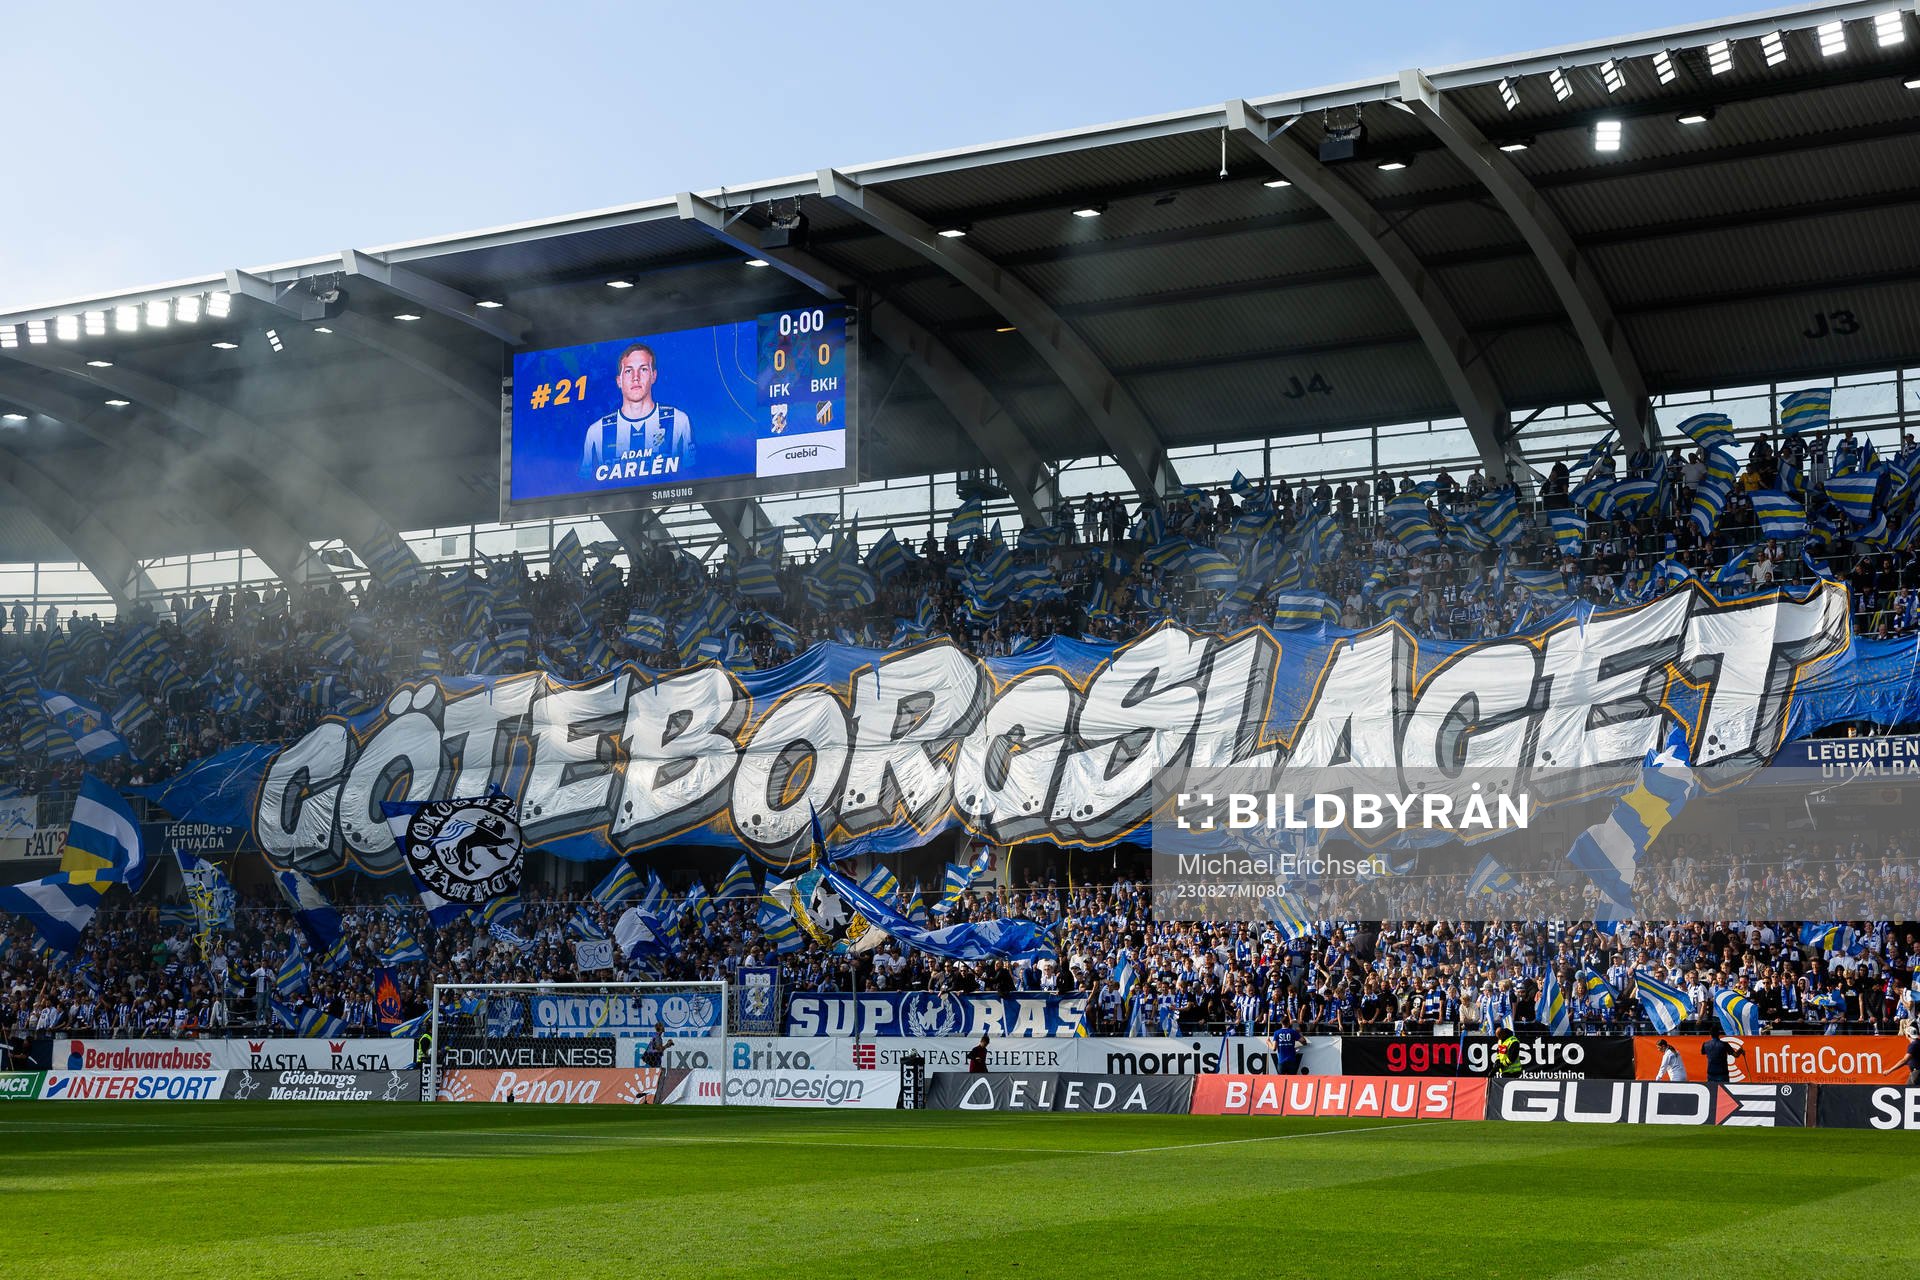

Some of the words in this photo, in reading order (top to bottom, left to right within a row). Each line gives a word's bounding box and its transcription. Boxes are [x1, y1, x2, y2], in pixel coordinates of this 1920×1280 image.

[779, 310, 824, 336] 0:00
[1804, 310, 1860, 339] J3
[774, 350, 786, 372] 0
[818, 344, 830, 366] 0
[530, 375, 588, 410] #21
[769, 383, 791, 398] IFK
[811, 376, 838, 393] BKH
[1281, 373, 1333, 399] J4
[596, 453, 680, 481] CARLÉN
[621, 448, 653, 461] ADAM
[785, 446, 818, 460] cuebid
[652, 487, 693, 500] SAMSUNG
[1822, 760, 1920, 778] UTVALDA
[172, 837, 225, 850] UTVALDA
[538, 998, 658, 1027] OKTOBER
[86, 1046, 211, 1070] Bergkvarabuss
[250, 1053, 308, 1071] RASTA
[331, 1053, 390, 1071] RASTA
[1107, 1042, 1219, 1075] morris
[1386, 1042, 1462, 1072] ggm
[1755, 1046, 1882, 1074] InfraCom
[67, 1076, 217, 1099] INTERSPORT
[280, 1070, 357, 1088] Göteborgs
[421, 1062, 431, 1102] SELECT
[491, 1071, 600, 1102] Renova
[903, 1065, 914, 1109] SELECT
[268, 1087, 372, 1100] Metallpartier
[1010, 1081, 1148, 1110] ELEDA
[1225, 1081, 1449, 1112] BAUHAUS
[1501, 1081, 1777, 1127] GUIDE
